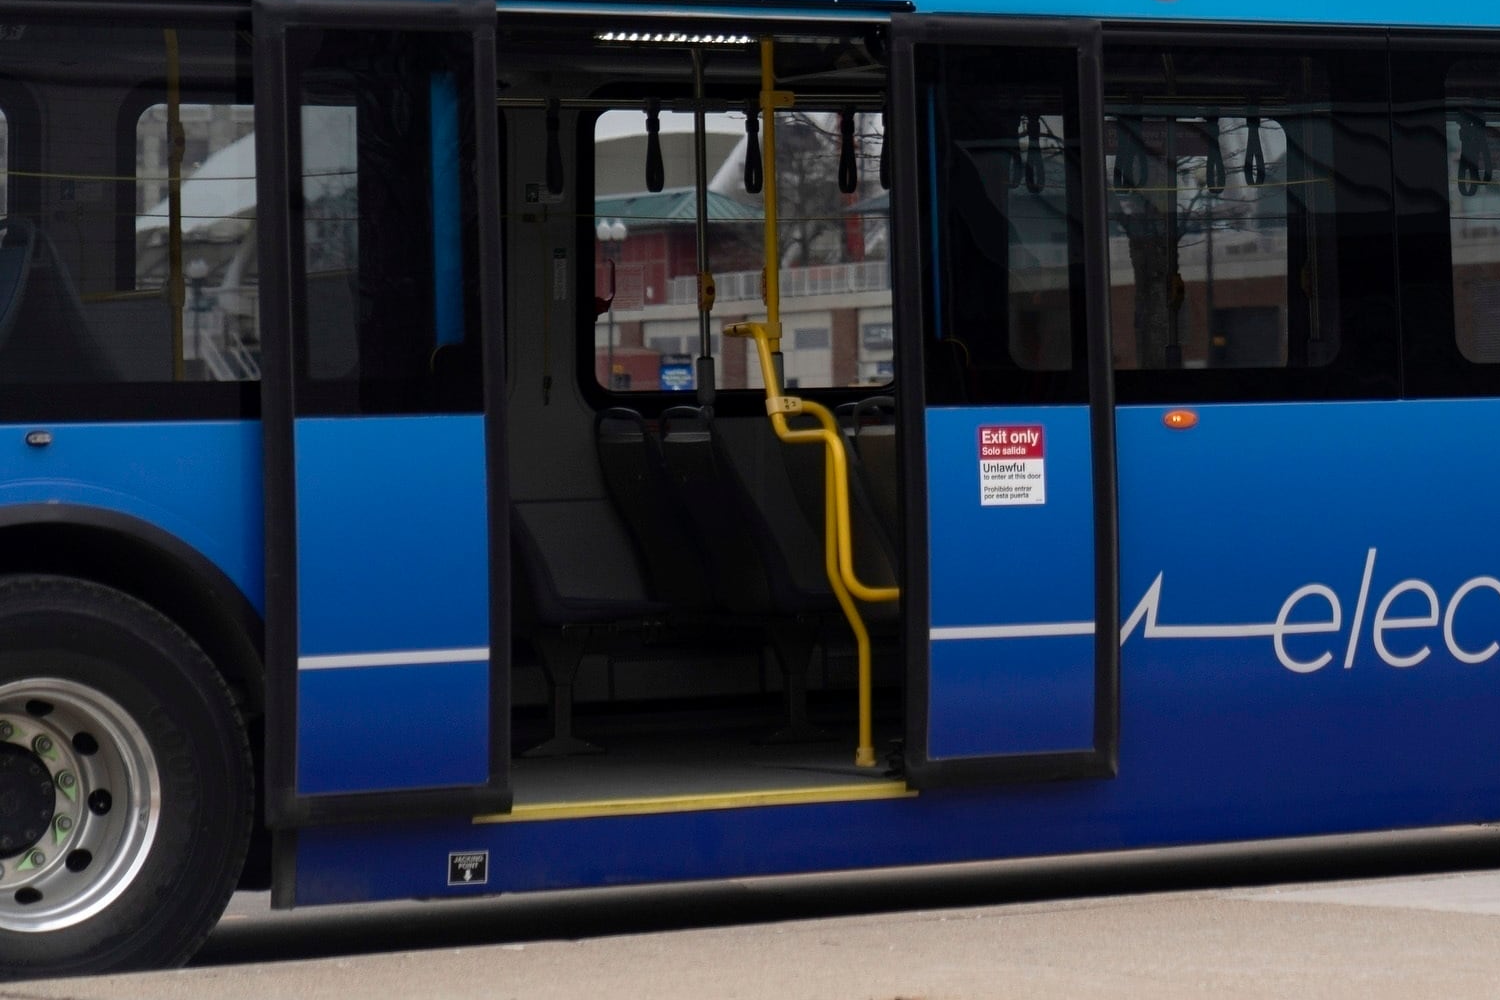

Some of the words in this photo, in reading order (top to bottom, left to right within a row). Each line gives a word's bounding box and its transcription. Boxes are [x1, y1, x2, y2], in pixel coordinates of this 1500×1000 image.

[982, 430, 1007, 444] Exit
[1010, 429, 1039, 447] only
[982, 446, 1001, 456] Solo
[1002, 446, 1026, 455] salida
[983, 462, 1025, 473] Unlawful
[1010, 492, 1029, 500] puerta
[453, 855, 484, 863] JACKING
[457, 862, 479, 870] POINT
